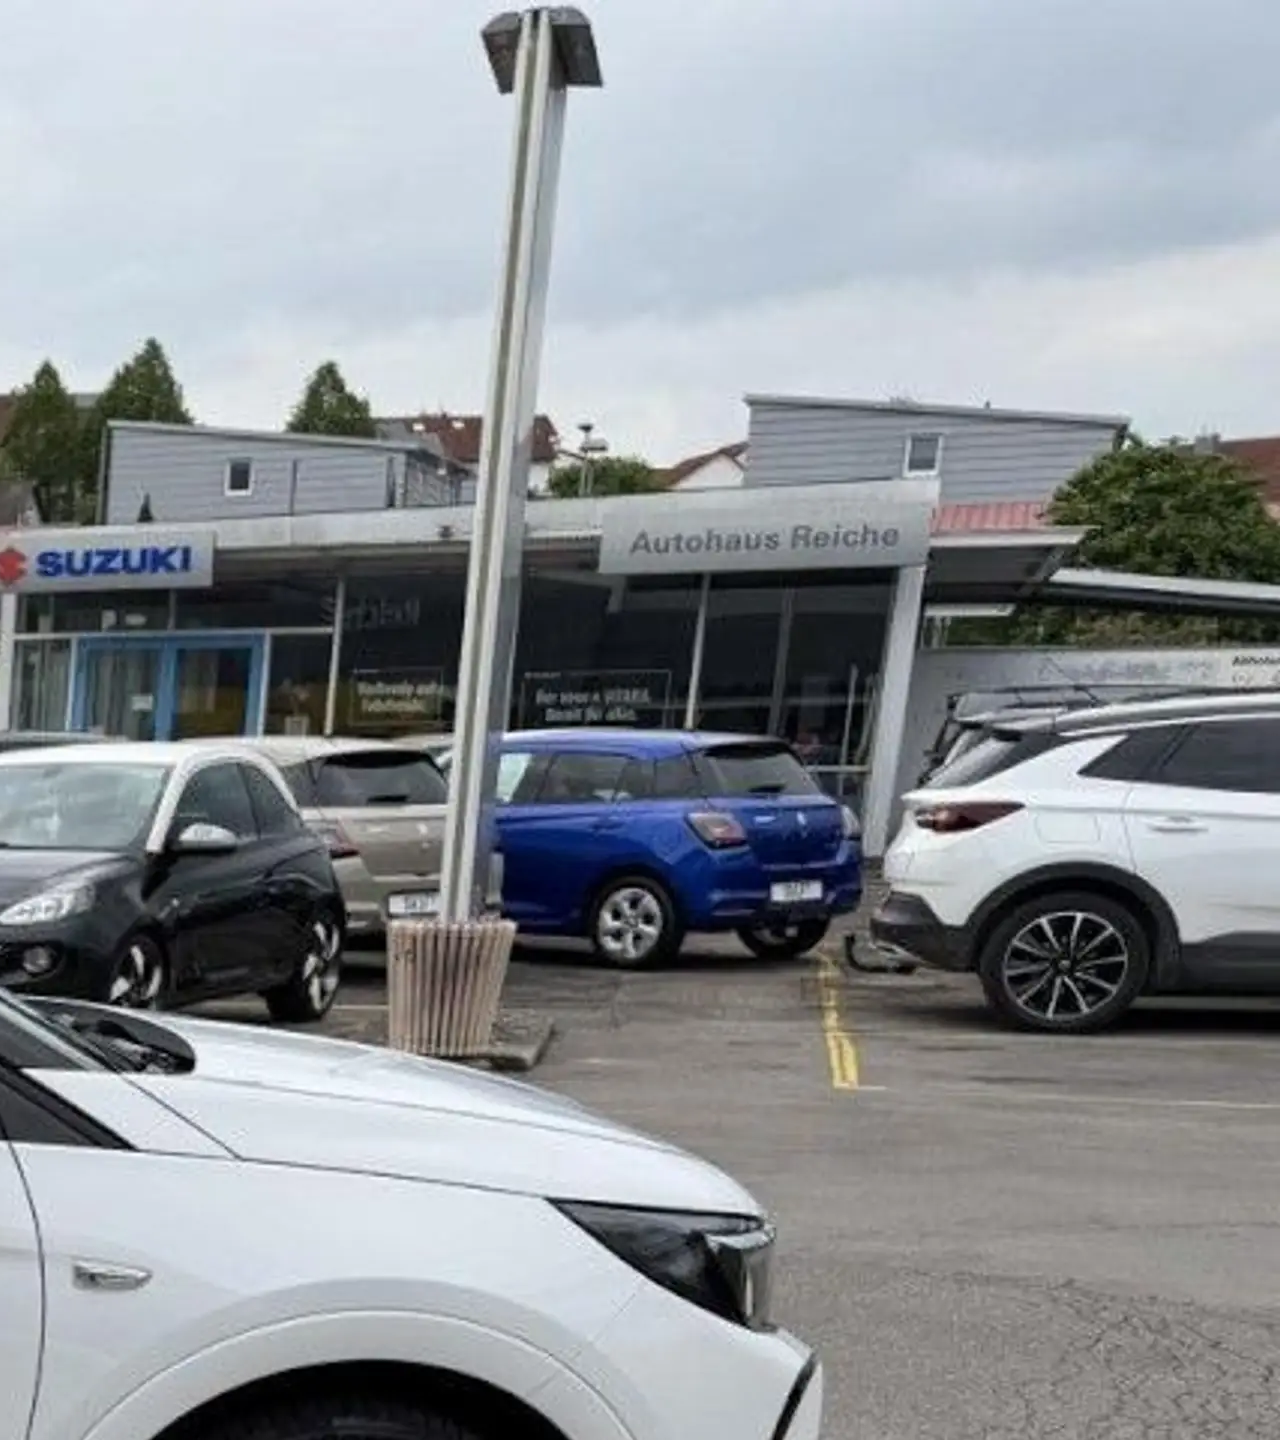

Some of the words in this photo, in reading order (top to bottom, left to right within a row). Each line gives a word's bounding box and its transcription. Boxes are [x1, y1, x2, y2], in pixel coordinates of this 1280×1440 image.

[629, 528, 781, 554] Autohaus
[791, 523, 900, 549] Reiche
[36, 545, 192, 577] SUZUKI
